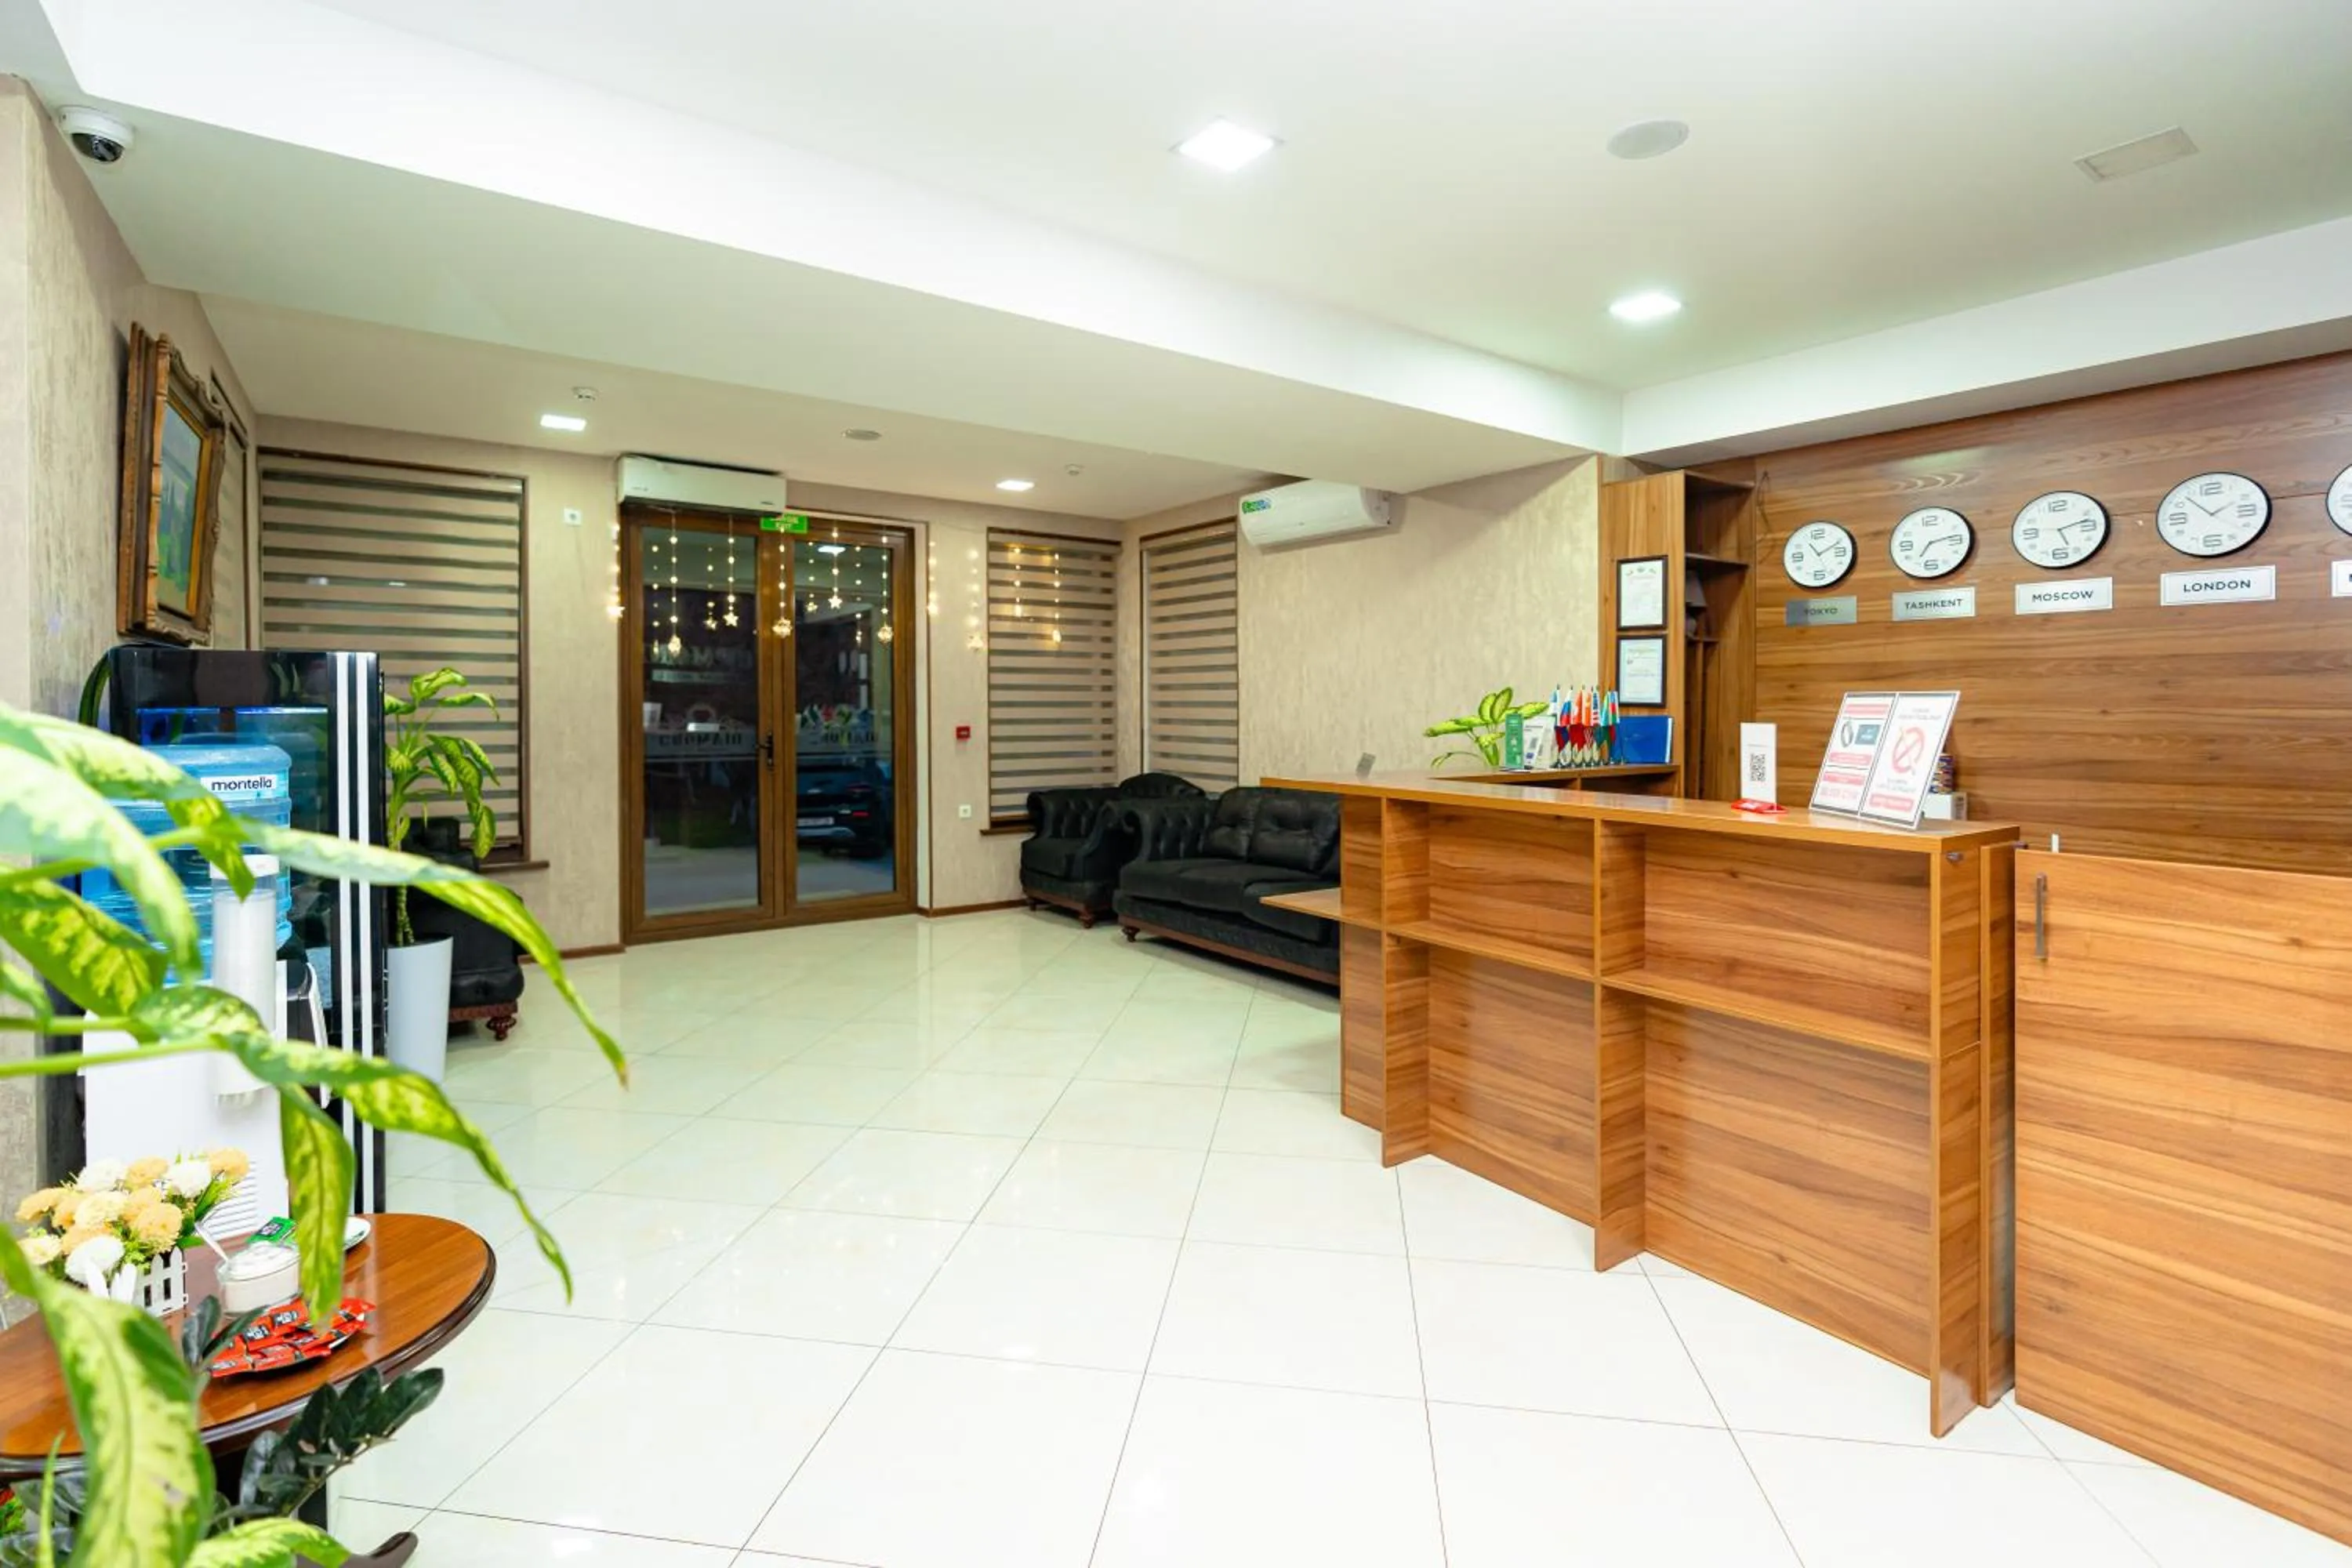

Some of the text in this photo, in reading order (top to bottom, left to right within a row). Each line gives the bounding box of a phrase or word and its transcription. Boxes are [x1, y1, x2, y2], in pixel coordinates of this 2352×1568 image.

[2183, 579, 2252, 593] LONDON
[2031, 589, 2095, 603] MOSCOW
[1904, 598, 1963, 610] TASHKENT
[1803, 608, 1838, 616] TOKYO
[211, 777, 272, 790] montella
